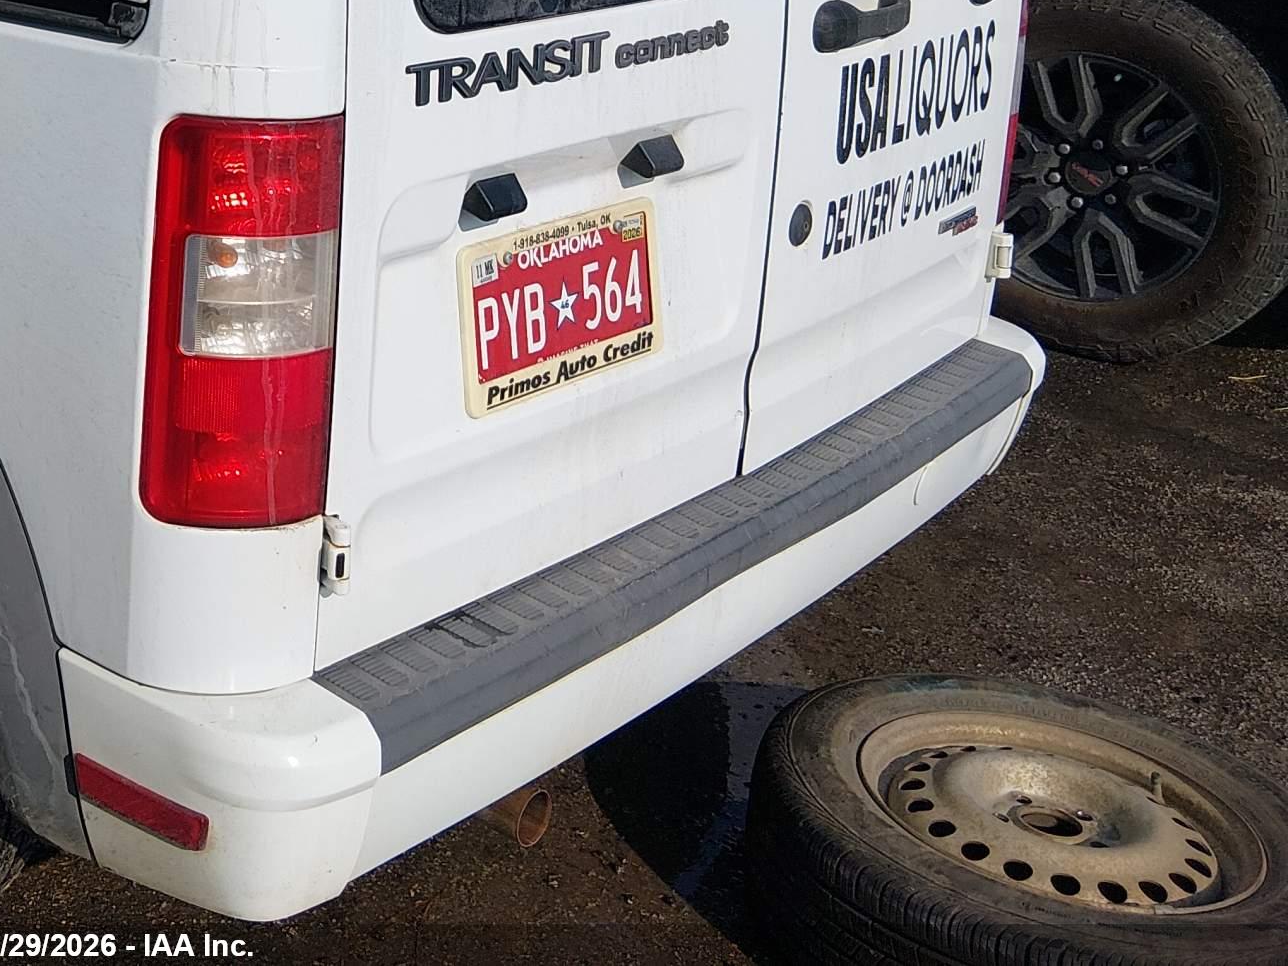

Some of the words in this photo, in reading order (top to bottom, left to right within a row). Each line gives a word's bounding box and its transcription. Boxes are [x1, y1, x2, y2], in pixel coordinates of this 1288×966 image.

[405, 31, 611, 106] TRANSIT
[615, 20, 729, 69] connect
[836, 53, 891, 164] USA
[891, 19, 995, 146] LIQUORS
[600, 213, 612, 225] OK
[623, 227, 641, 240] 2026
[821, 175, 901, 260] DELIVERY
[900, 169, 915, 227] @
[914, 139, 986, 221] DOORDASH
[517, 229, 604, 270] OKLAHOMA
[478, 282, 547, 370] PYB
[582, 248, 643, 331] 564
[487, 371, 551, 405] Primos
[556, 355, 598, 383] Auto
[603, 331, 654, 362] Credit
